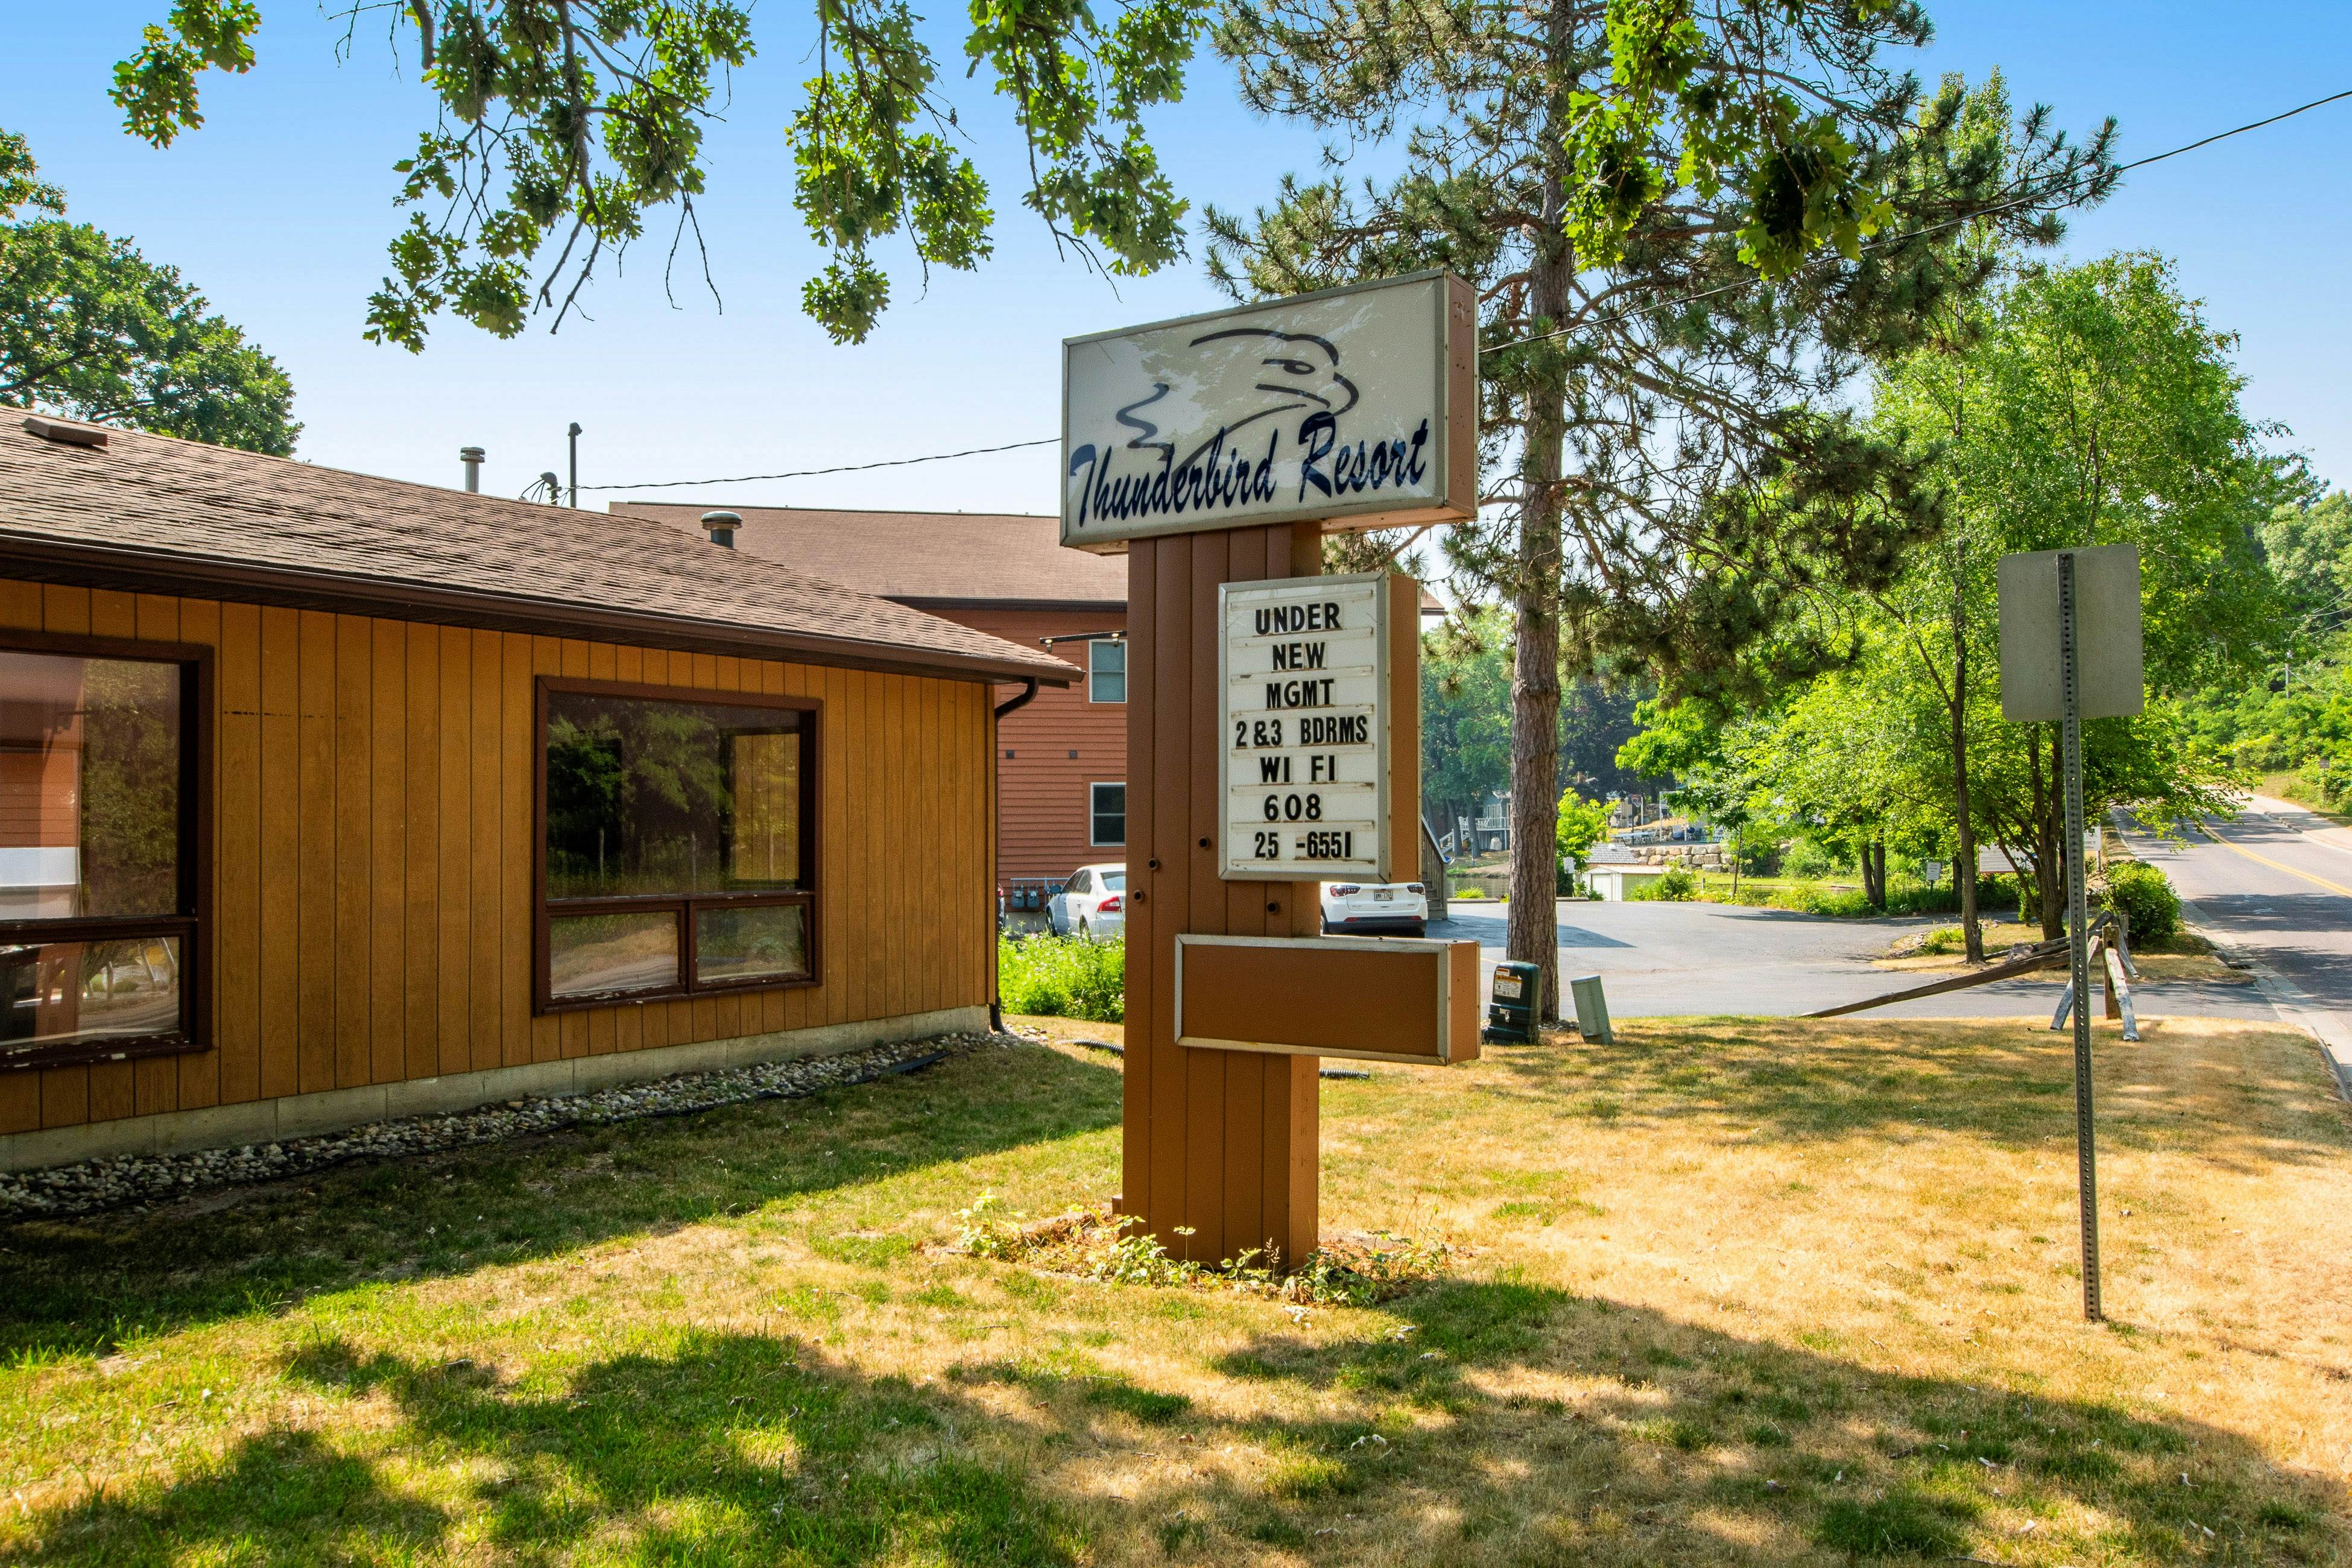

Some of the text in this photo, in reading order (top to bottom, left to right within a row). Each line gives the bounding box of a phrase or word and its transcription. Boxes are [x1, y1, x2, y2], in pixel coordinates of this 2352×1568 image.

[1069, 411, 1429, 527] Thunderbird Resort
[1255, 602, 1341, 634] UNDER
[1272, 642, 1325, 670] NEW
[1266, 679, 1334, 708] MGMT
[1300, 715, 1367, 744] BDRMS
[1260, 755, 1335, 782] WI FI
[1264, 794, 1321, 821] 608
